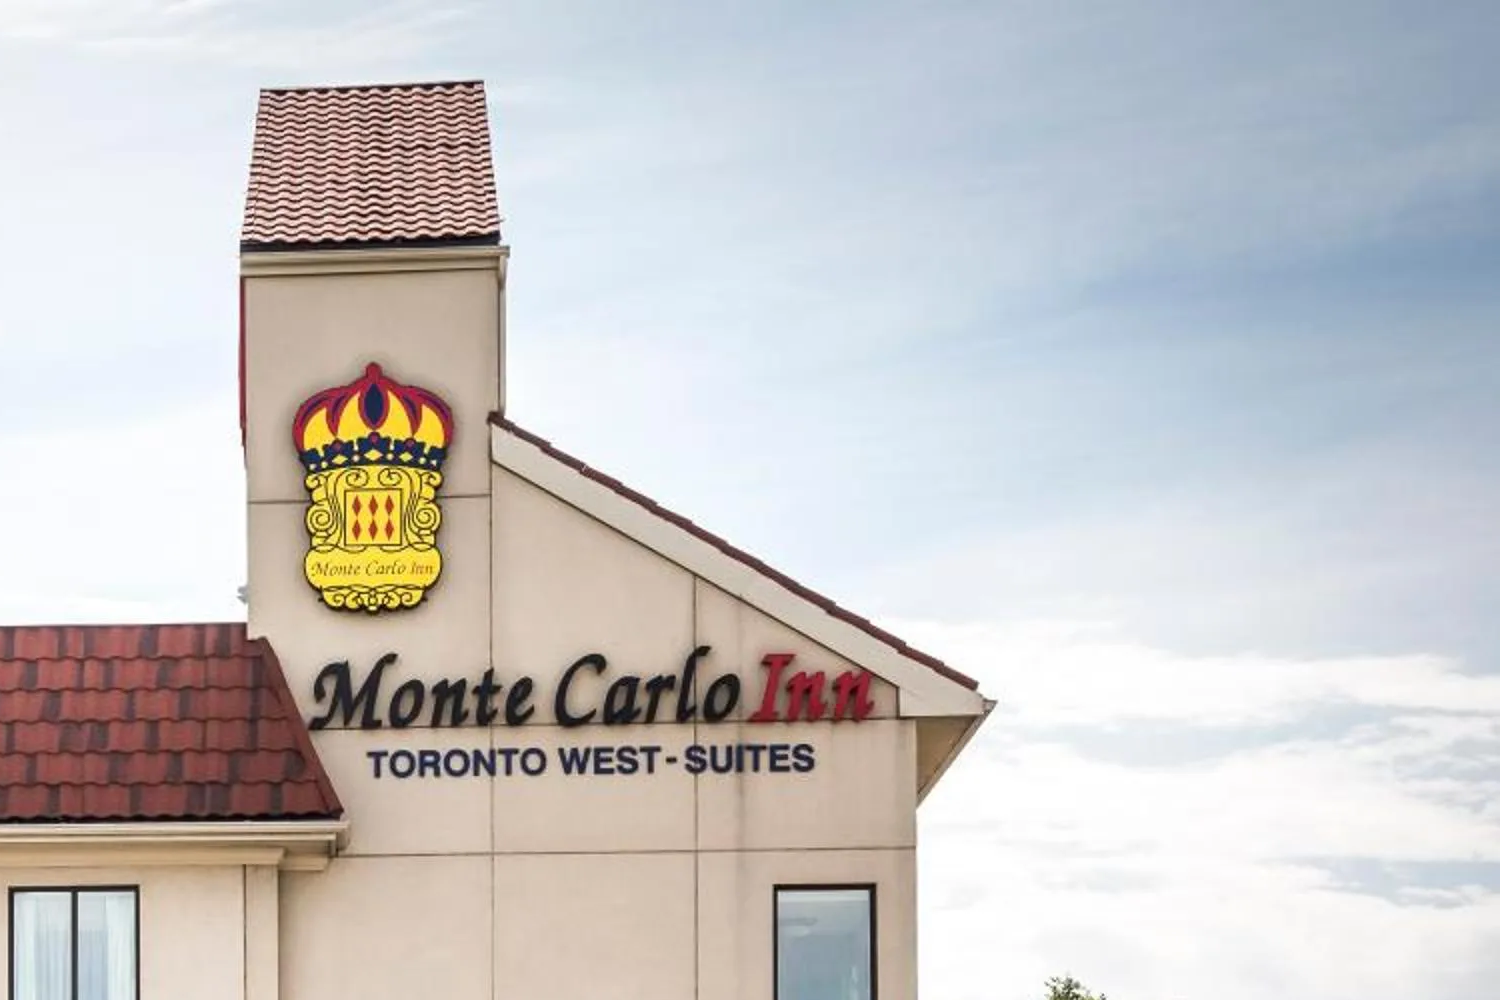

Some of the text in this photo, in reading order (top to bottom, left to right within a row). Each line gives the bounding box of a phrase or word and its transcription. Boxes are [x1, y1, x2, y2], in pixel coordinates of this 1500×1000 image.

[311, 561, 361, 577] Monte
[365, 560, 406, 576] Carlo
[307, 645, 875, 732] Monte Carlo Inn
[366, 748, 548, 779] TORONTO
